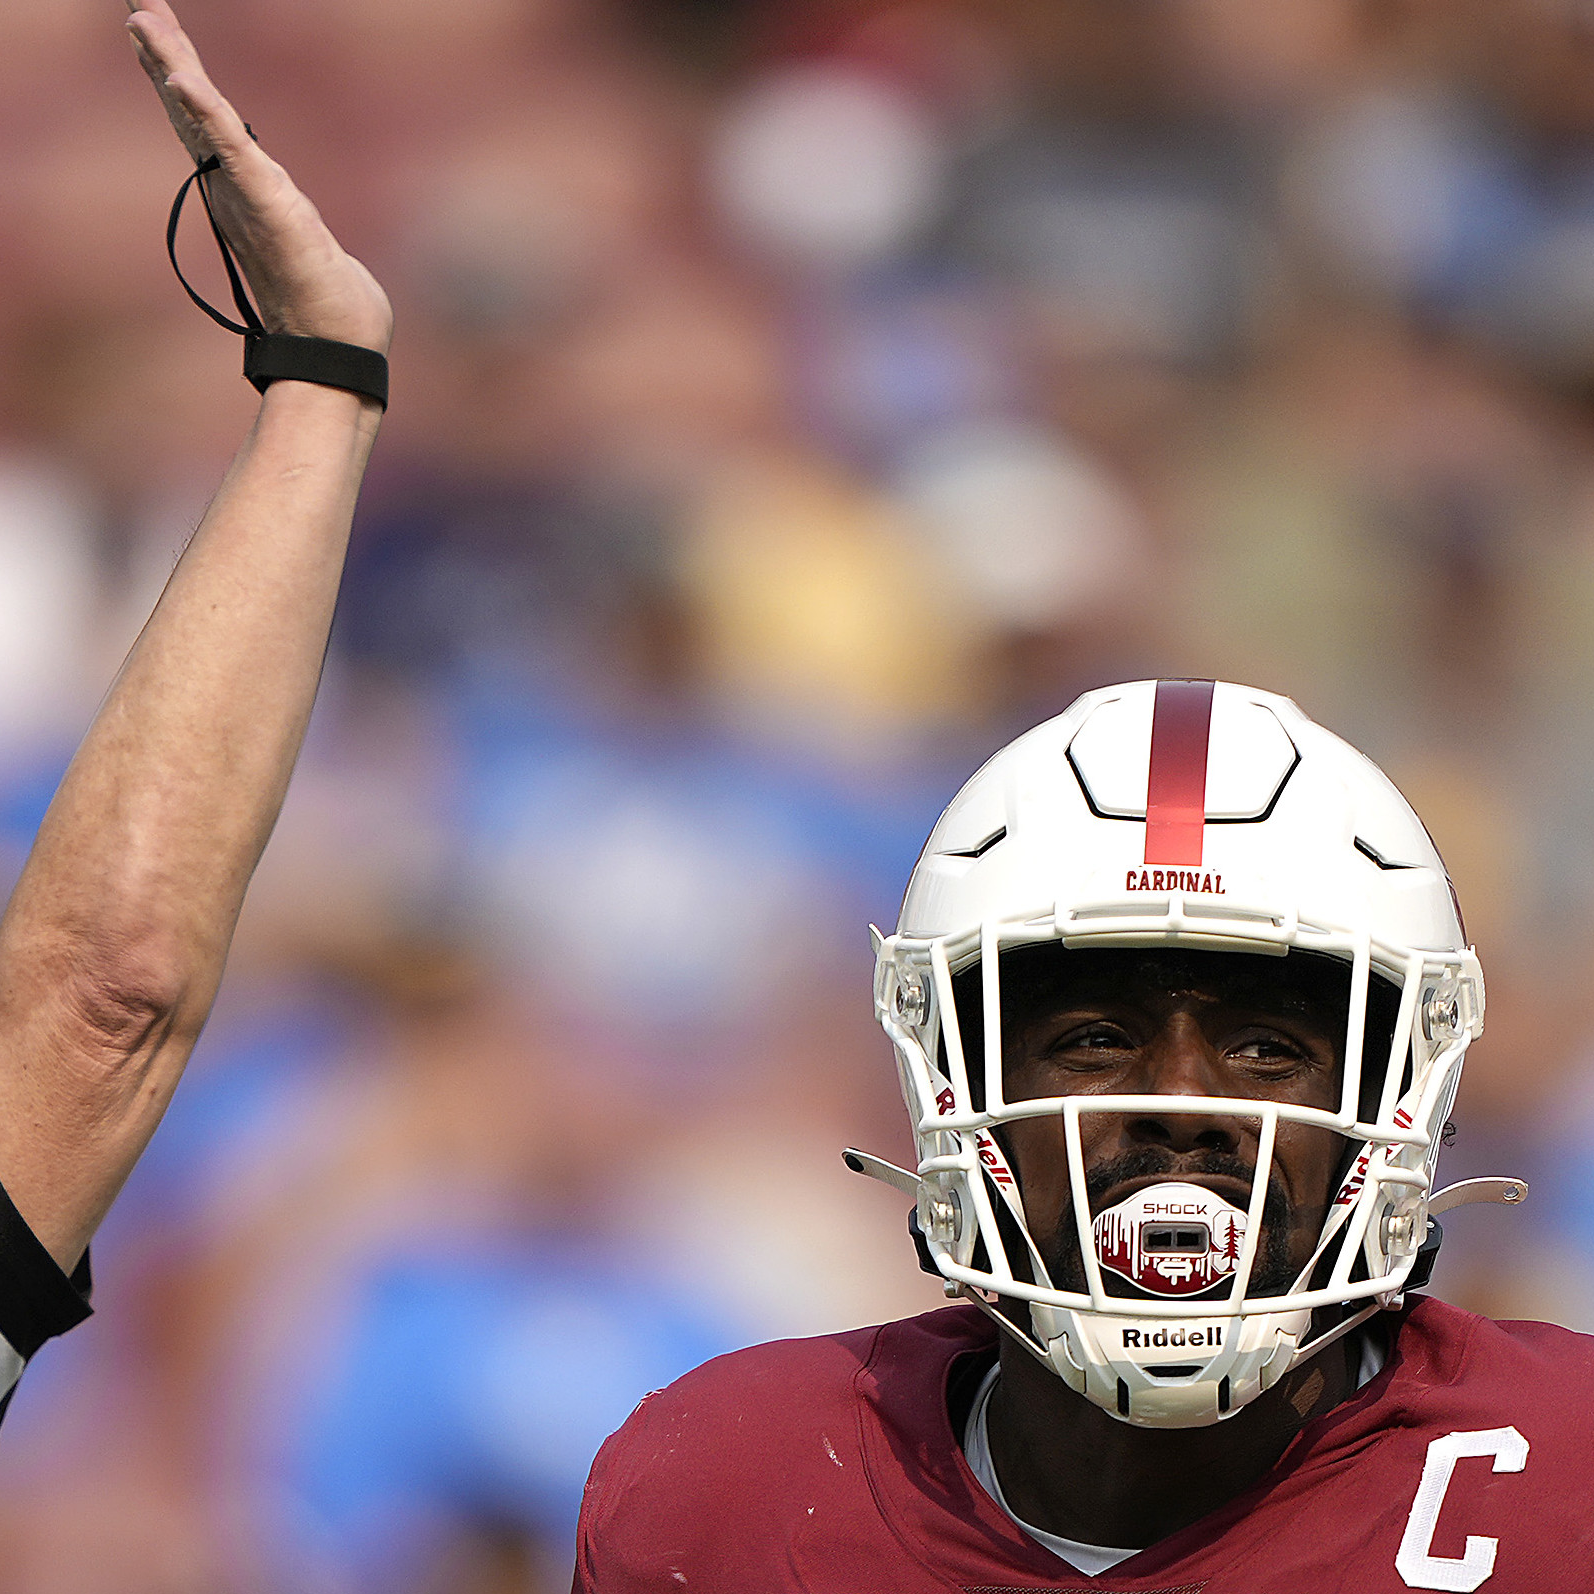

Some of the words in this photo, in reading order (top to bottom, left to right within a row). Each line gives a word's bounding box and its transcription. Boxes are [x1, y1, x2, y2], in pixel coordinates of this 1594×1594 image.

[1126, 870, 1226, 894] CARDINAL
[1143, 1203, 1208, 1215] SHOCK
[1122, 1326, 1222, 1349] Riddell
[1393, 1426, 1528, 1593] C
